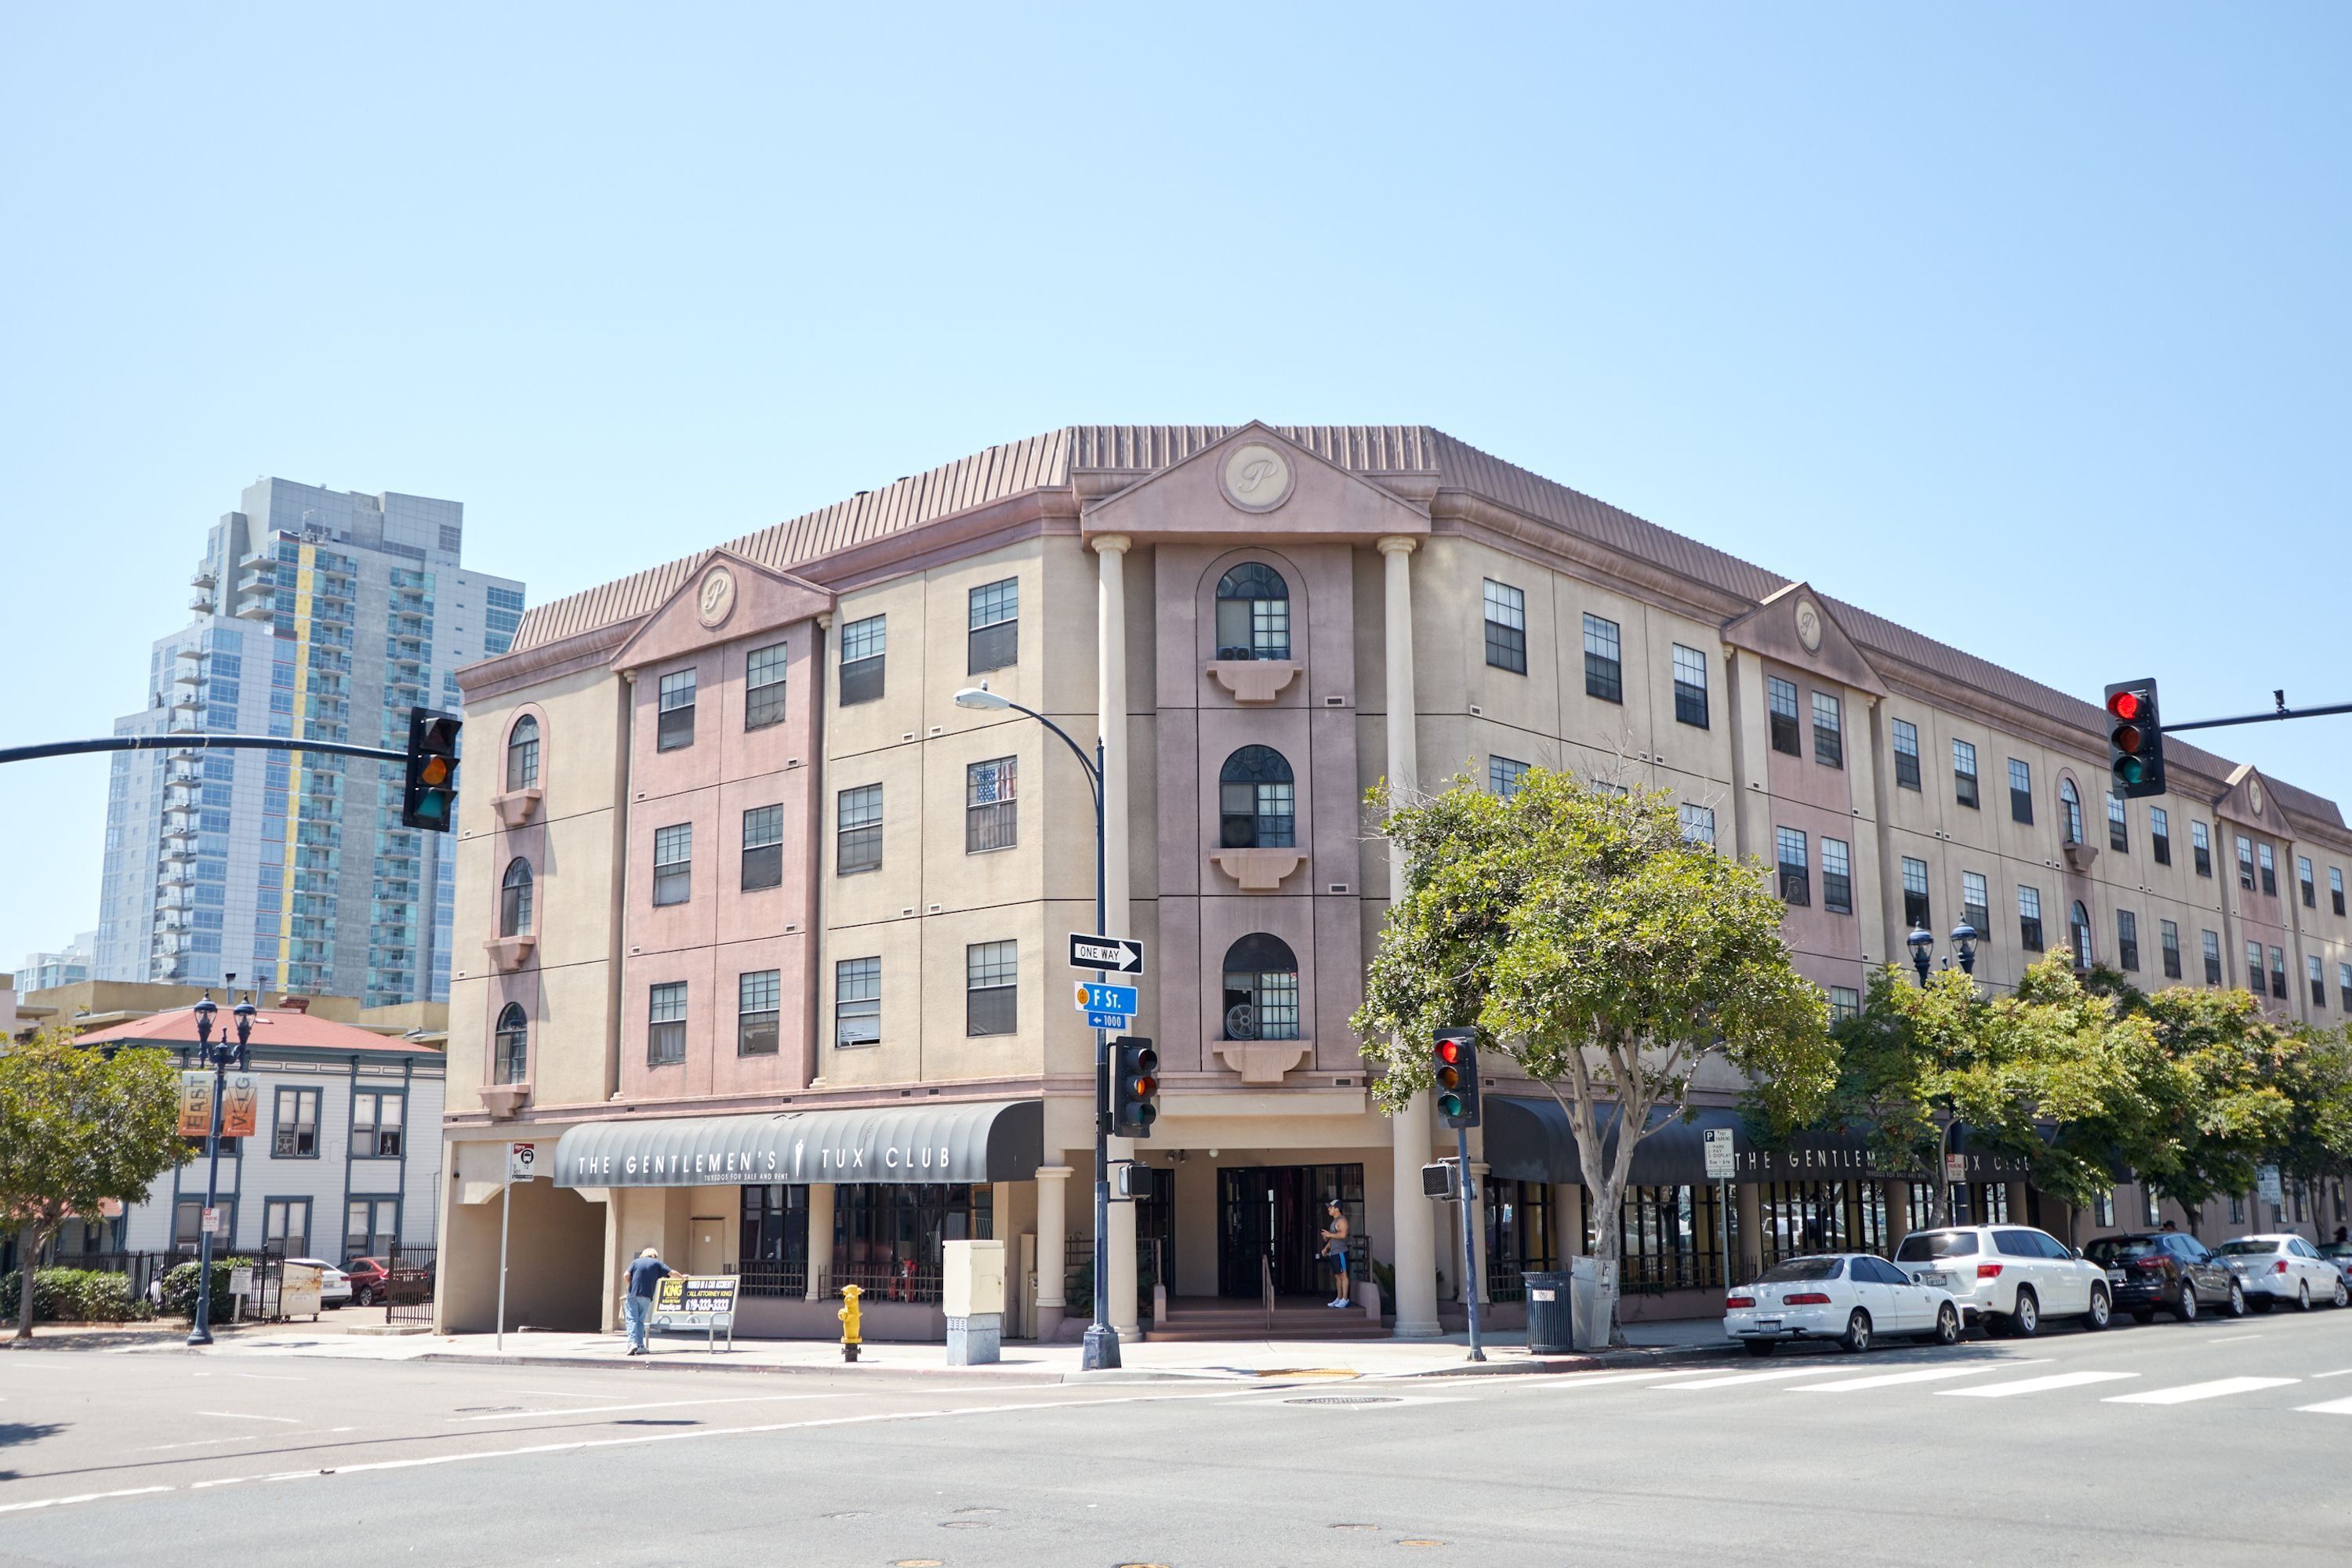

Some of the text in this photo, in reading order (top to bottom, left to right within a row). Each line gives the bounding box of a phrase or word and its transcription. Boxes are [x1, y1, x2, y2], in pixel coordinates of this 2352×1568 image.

[1080, 946, 1120, 960] ONE WAY
[1094, 989, 1100, 1007] F
[1104, 1014, 1121, 1027] 1000
[1707, 1131, 1713, 1142] P
[578, 1147, 949, 1174] THE GENTLEMEN'S TUX CLUB
[1735, 1152, 1770, 1171] THE
[663, 1284, 683, 1297] KING
[685, 1298, 729, 1311] 619-333-3333
